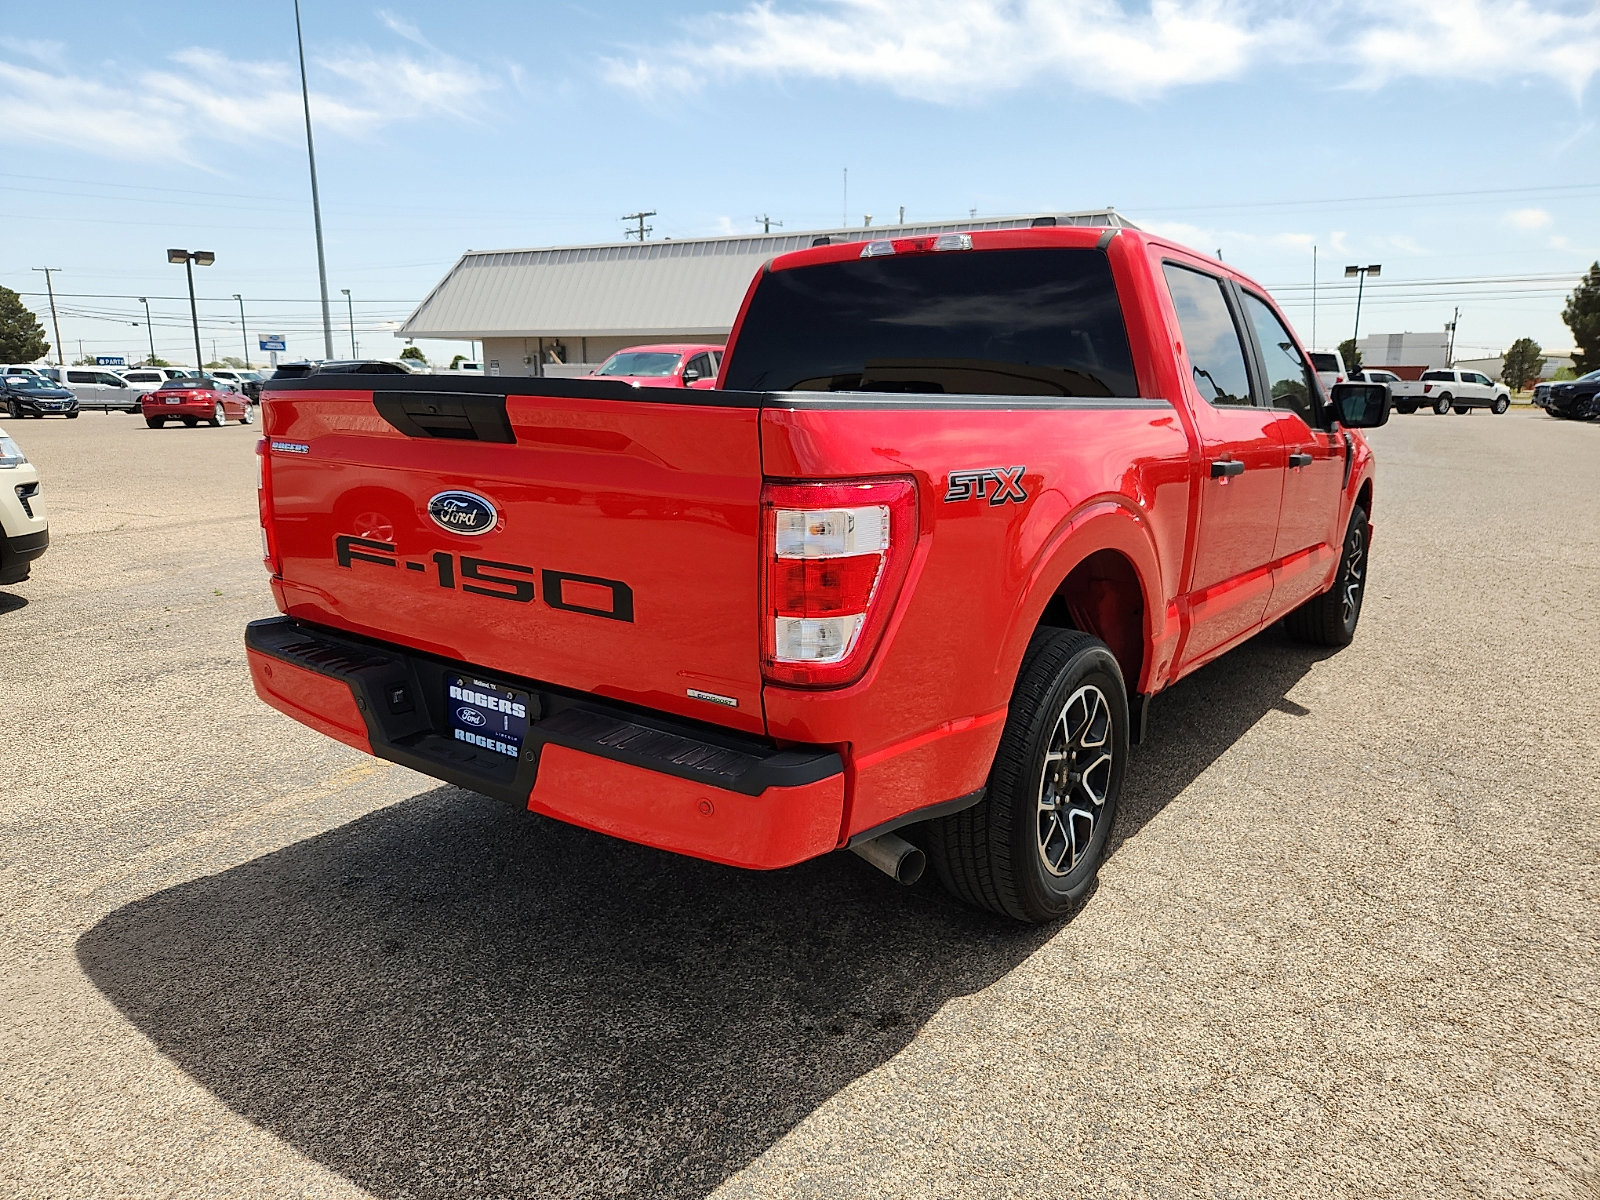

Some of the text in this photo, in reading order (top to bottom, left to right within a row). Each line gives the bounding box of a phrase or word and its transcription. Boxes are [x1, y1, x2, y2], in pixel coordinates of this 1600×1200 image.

[944, 465, 1028, 507] STX
[441, 499, 477, 527] Ford
[336, 535, 635, 624] F-150
[449, 685, 526, 719] ROGERS
[461, 709, 481, 725] Ford
[454, 728, 518, 758] ROGERS
